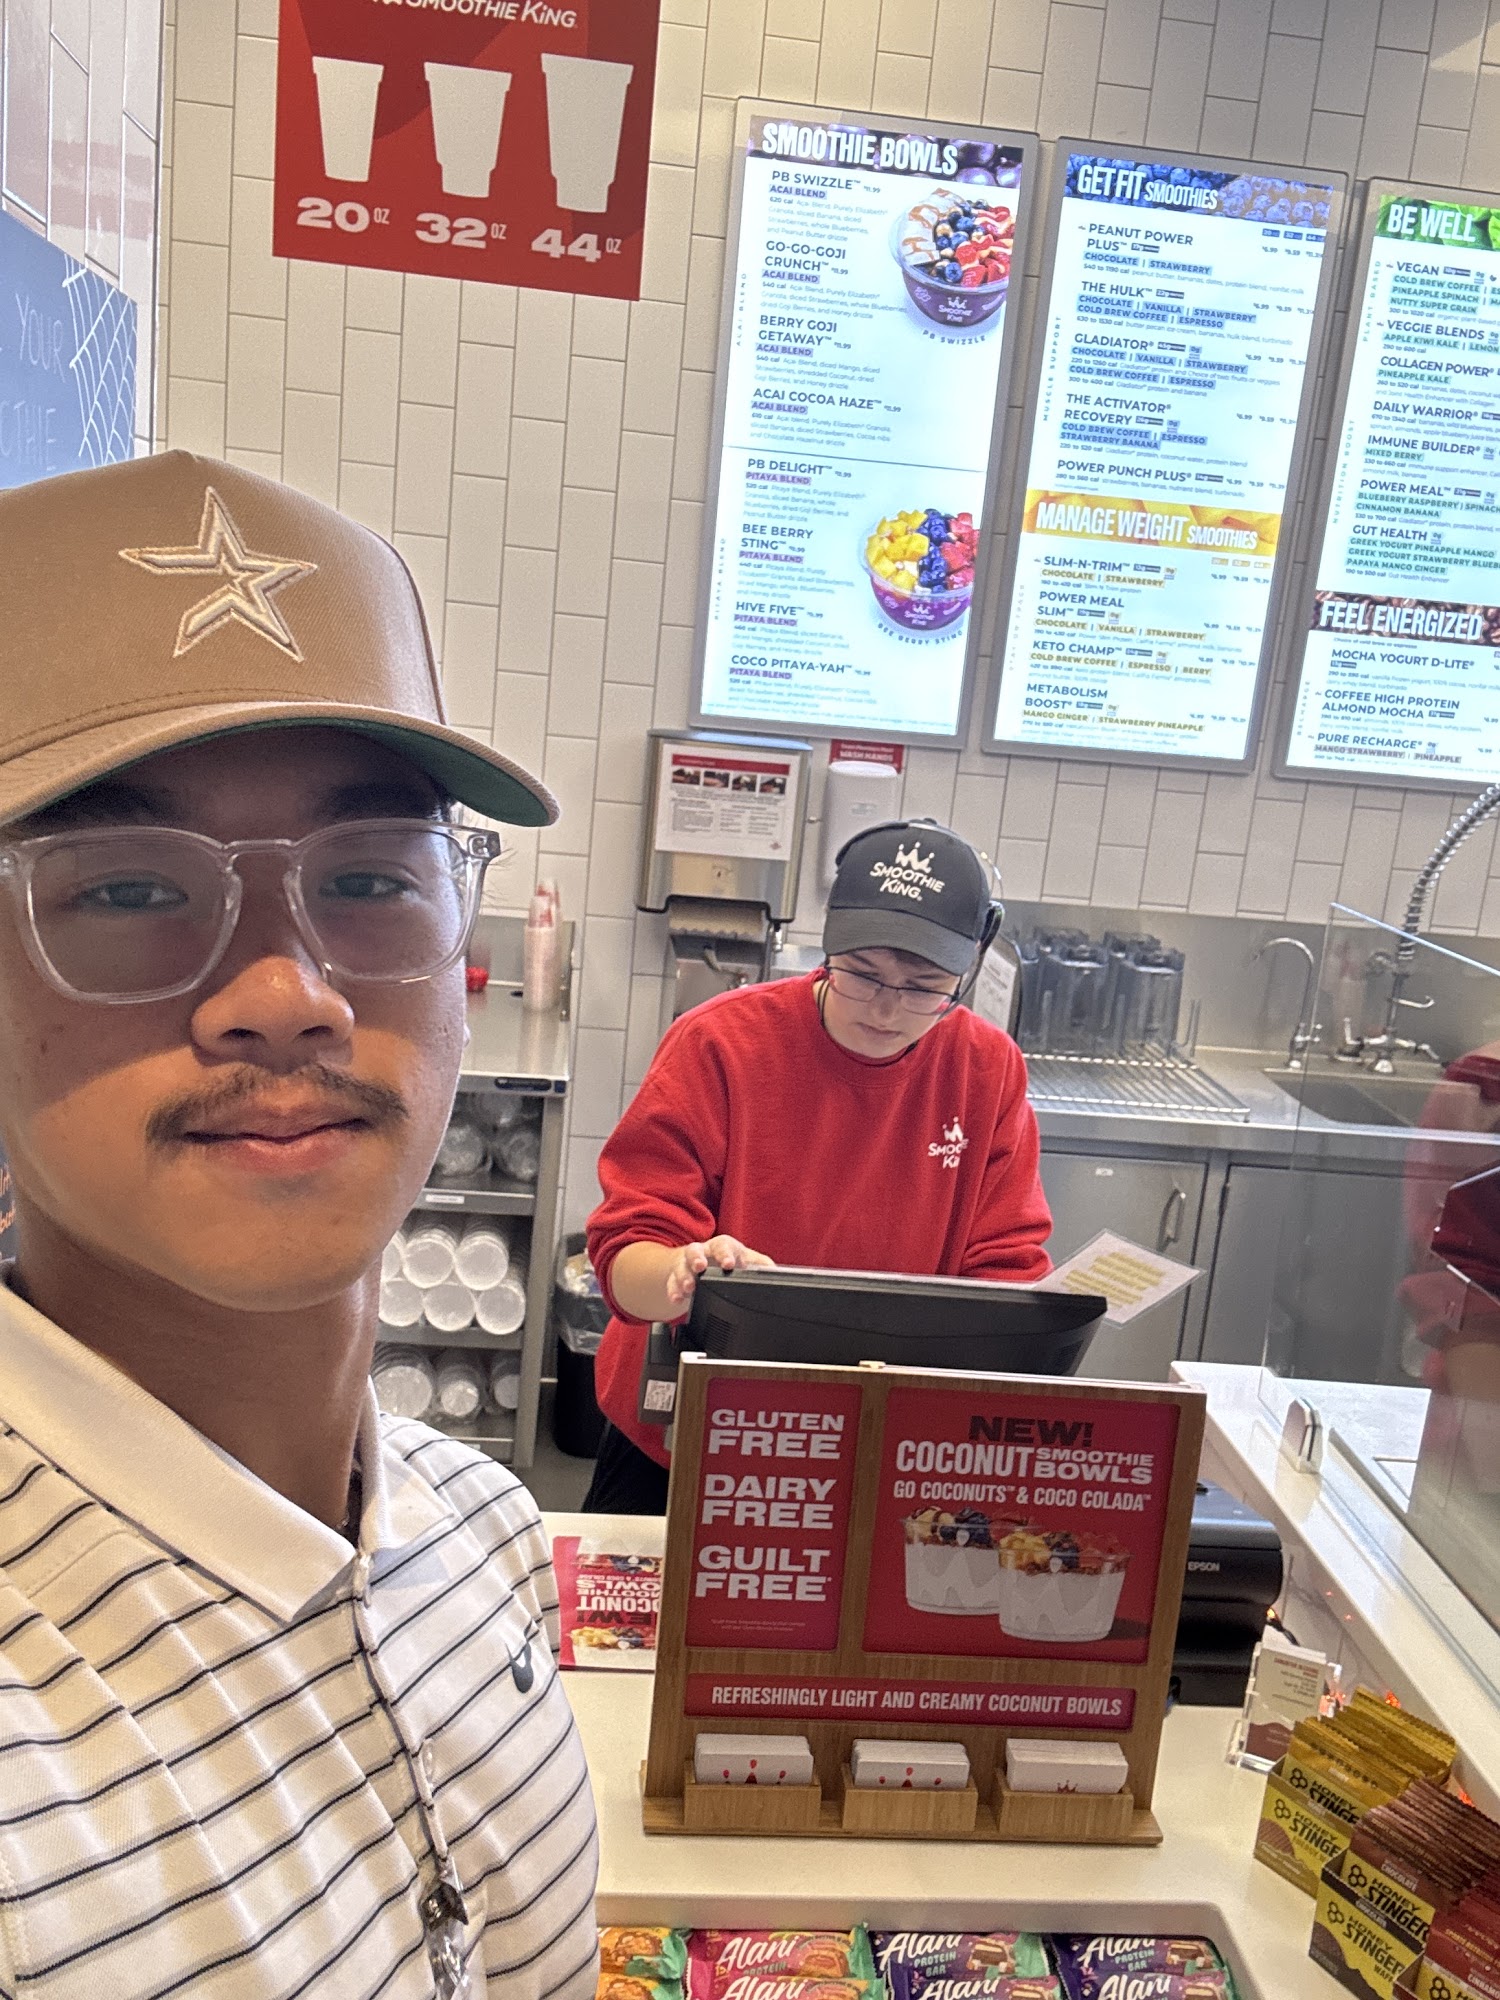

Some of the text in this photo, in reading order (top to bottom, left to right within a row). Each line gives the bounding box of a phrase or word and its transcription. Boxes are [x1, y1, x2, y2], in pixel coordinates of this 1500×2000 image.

[762, 123, 958, 177] SMOOTHIE BOWLS
[772, 170, 790, 182] PB
[1078, 164, 1219, 209] GET FIT SMOOTHIES
[770, 185, 826, 198] ACAI BLEND
[297, 197, 390, 233] 20 OZ
[1387, 204, 1476, 243] BE WELL
[415, 212, 506, 249] 32 OZ
[1088, 223, 1194, 245] PEANUT POWER
[531, 228, 622, 262] 44 OZ
[766, 240, 846, 260] GO-GO-GOJI
[1084, 252, 1211, 274] CHOCOLATE STRAWBERRY
[1397, 261, 1439, 276] VEGAN
[1081, 280, 1106, 293] THE
[1392, 286, 1479, 303] PINEAPPLE SPINACH
[759, 315, 837, 333] BERRY GOJI
[1387, 319, 1485, 340] VEGGIE BLENDS
[1380, 356, 1443, 371] COLLAGEN
[753, 388, 785, 400] ACAI
[789, 390, 835, 406] COCOA
[1067, 393, 1091, 405] THE
[1373, 400, 1409, 413] DAILY
[1064, 409, 1132, 425] RECOVERY
[1367, 435, 1419, 449] IMMUNE
[748, 458, 765, 469] PB
[1057, 459, 1105, 473] POWER
[1108, 464, 1152, 479] PUNCH
[746, 472, 810, 485] PITAYA BLEND
[1360, 479, 1406, 493] POWER
[742, 523, 813, 539] BEE BERRY
[1035, 501, 1258, 549] MANAGE WEIGHT SMOOTHIES
[1353, 525, 1428, 541] GUT HEALTH
[736, 601, 765, 613] HIVE
[1039, 591, 1125, 608] POWER MEAL
[1320, 600, 1483, 641] FEEL ENERGIZED
[1032, 640, 1065, 652] KETO
[731, 655, 767, 667] COCO
[1332, 649, 1376, 661] MOCHA
[1380, 653, 1429, 666] YOGURT
[1026, 683, 1108, 698] METABOLISM
[1324, 689, 1460, 710] COFFEE HIGH PROTEIN
[1322, 702, 1424, 719] ALMOND MOCHA
[1317, 733, 1350, 743] PURE
[870, 862, 945, 893] SMOOTHIE
[711, 1409, 844, 1431] GLUTEN
[969, 1415, 1094, 1448] NEW!
[708, 1429, 842, 1460] FREE
[896, 1440, 1154, 1478] COCONUT SMOOTHIE
[1034, 1460, 1153, 1485] BOWLS
[704, 1474, 837, 1501] DAIRY
[893, 1480, 916, 1499] GO
[1017, 1488, 1028, 1504] &
[1034, 1488, 1077, 1507] COCO
[701, 1499, 834, 1529] FREE
[698, 1545, 831, 1573] GUILT
[1188, 1561, 1220, 1571] EPSON
[712, 1686, 1122, 1716] REFRESHINGLY LIGHT AND CREAMY COCONUT BOWLS
[1308, 1787, 1360, 1825] STINGE
[1313, 1780, 1359, 1811] HONEY
[1295, 1811, 1338, 1840] HONEY
[1289, 1818, 1342, 1857] STINGE
[1371, 1878, 1421, 1912] HONEY
[1364, 1886, 1430, 1941] STINGER
[1348, 1915, 1393, 1951] HONEY
[717, 1935, 800, 1971] Alani
[876, 1933, 964, 1970] Alani
[914, 1952, 957, 1968] PROTEIN
[1079, 1937, 1156, 1965] Alani
[1115, 1950, 1154, 1964] PROTEIN
[925, 1965, 946, 1977] BAR
[1127, 1960, 1148, 1971] BAR
